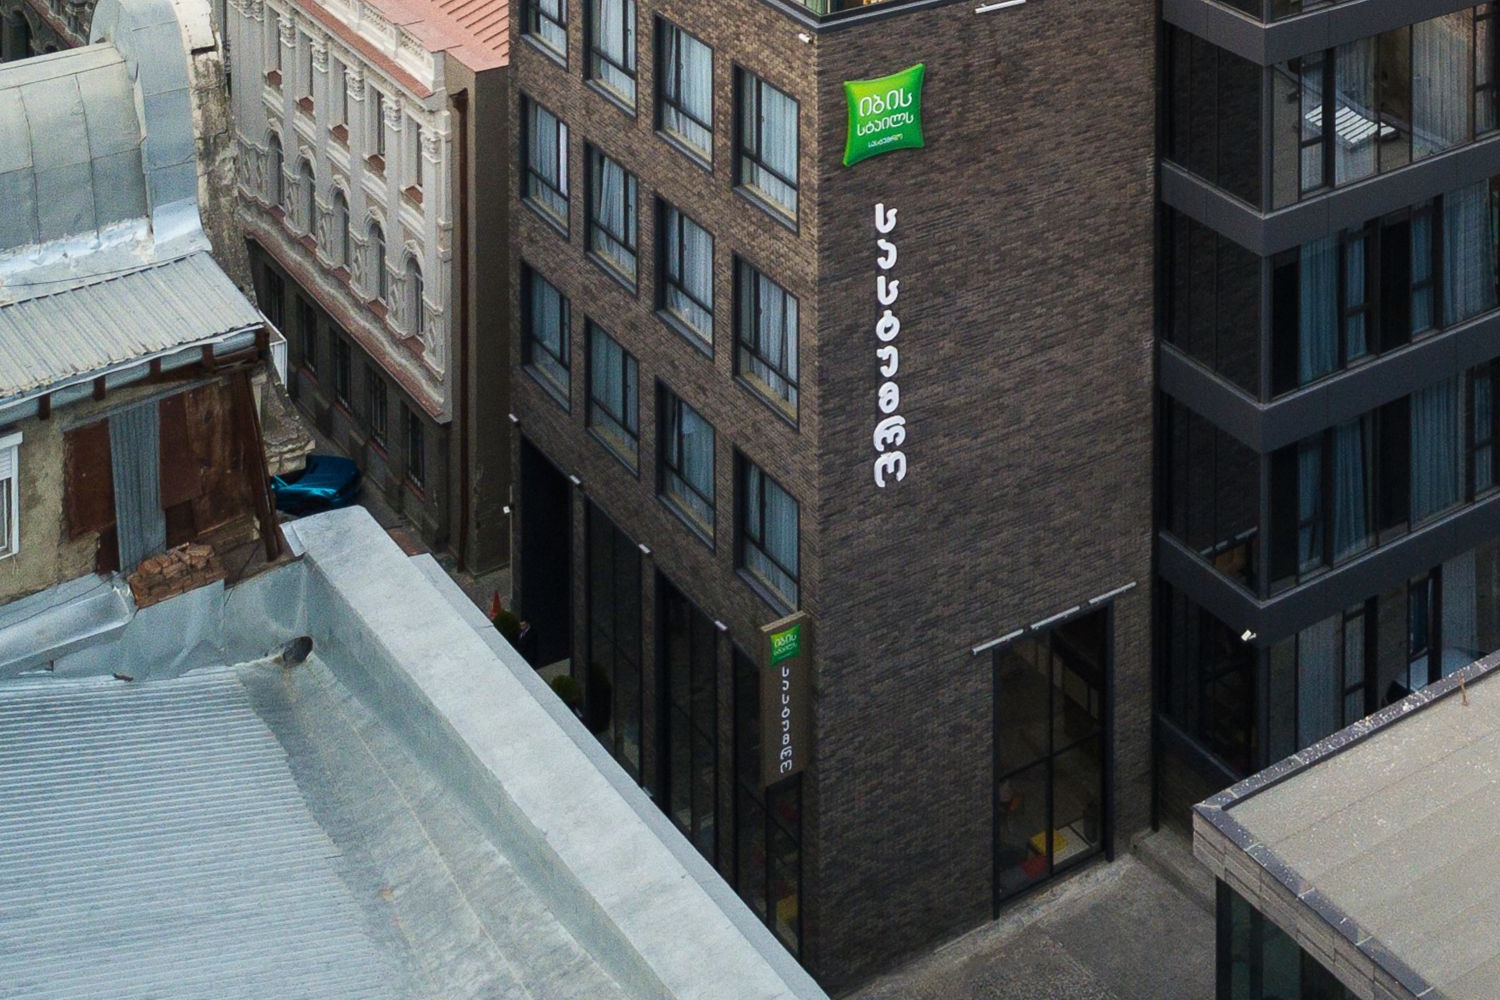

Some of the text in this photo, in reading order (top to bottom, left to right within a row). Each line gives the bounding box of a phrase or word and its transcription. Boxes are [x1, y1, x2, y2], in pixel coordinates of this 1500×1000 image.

[856, 111, 915, 137] სტაილს
[859, 87, 913, 117] იბის
[873, 203, 907, 488] სასტუმრო
[780, 666, 792, 774] სასტუმრო
